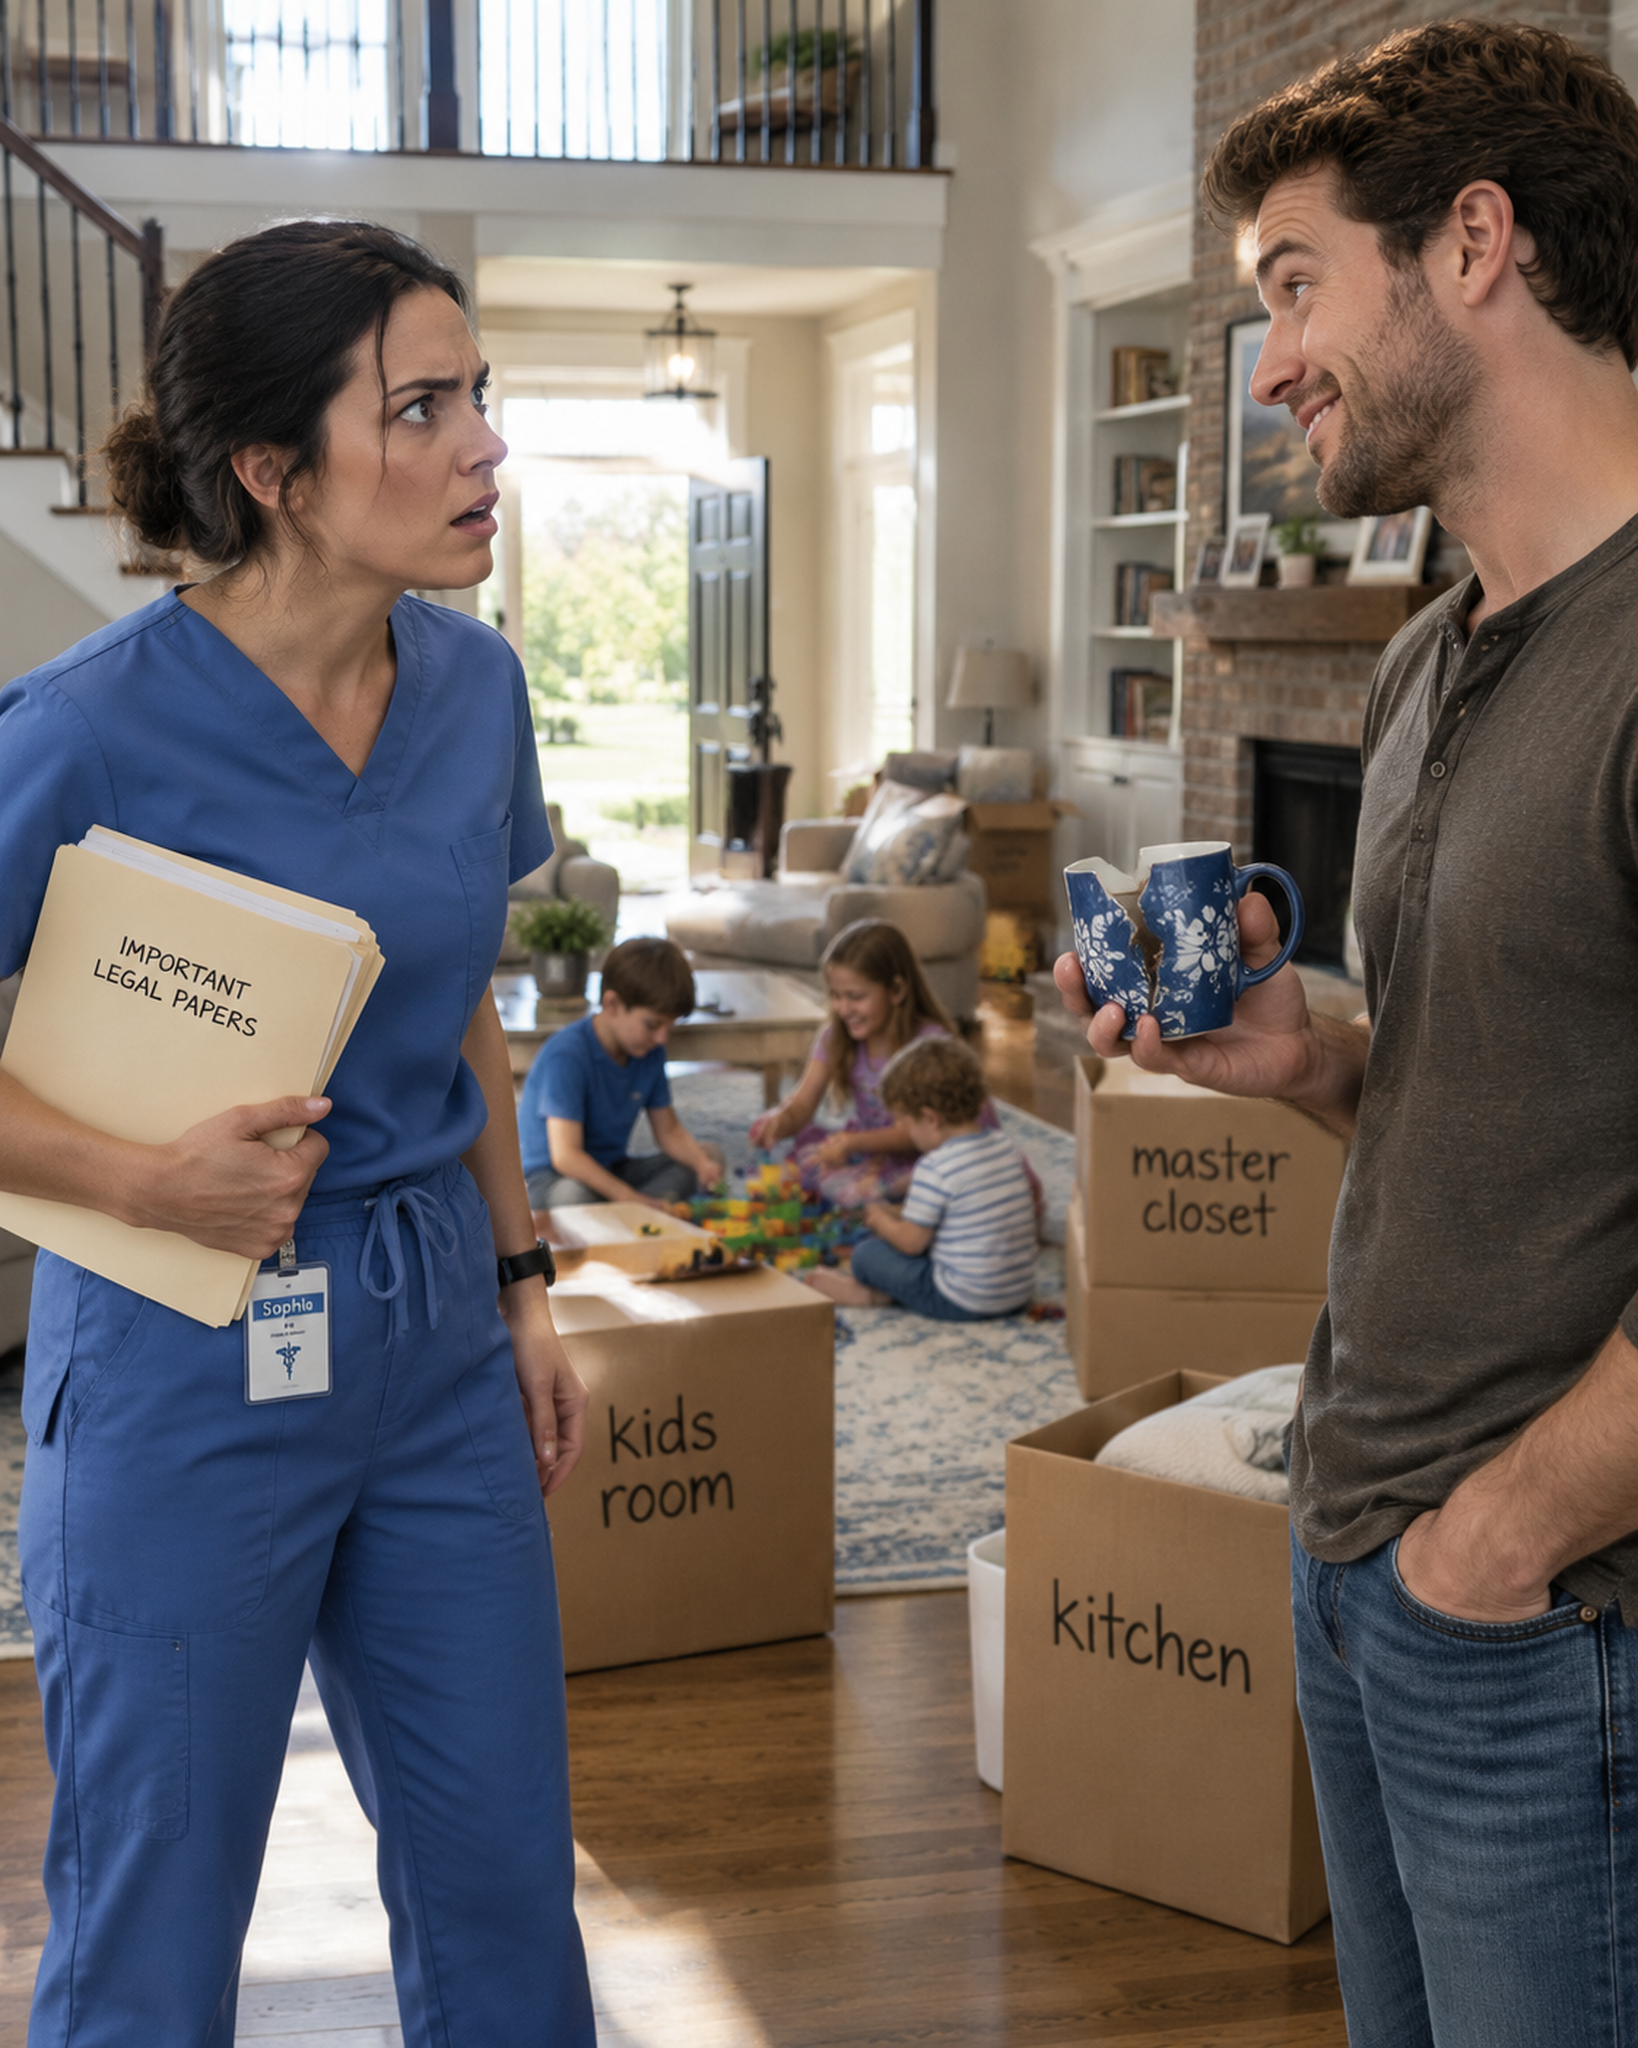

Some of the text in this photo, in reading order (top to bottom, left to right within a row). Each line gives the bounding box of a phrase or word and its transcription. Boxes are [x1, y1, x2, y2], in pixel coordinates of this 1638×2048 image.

[93, 958, 258, 1037] LEGAL PAPERS
[119, 936, 252, 999] IMPORTANT
[1133, 1135, 1291, 1182] master
[1143, 1188, 1277, 1237] closet
[609, 1395, 717, 1464] kids
[602, 1472, 733, 1528] room
[1053, 1578, 1251, 1693] kitchen
